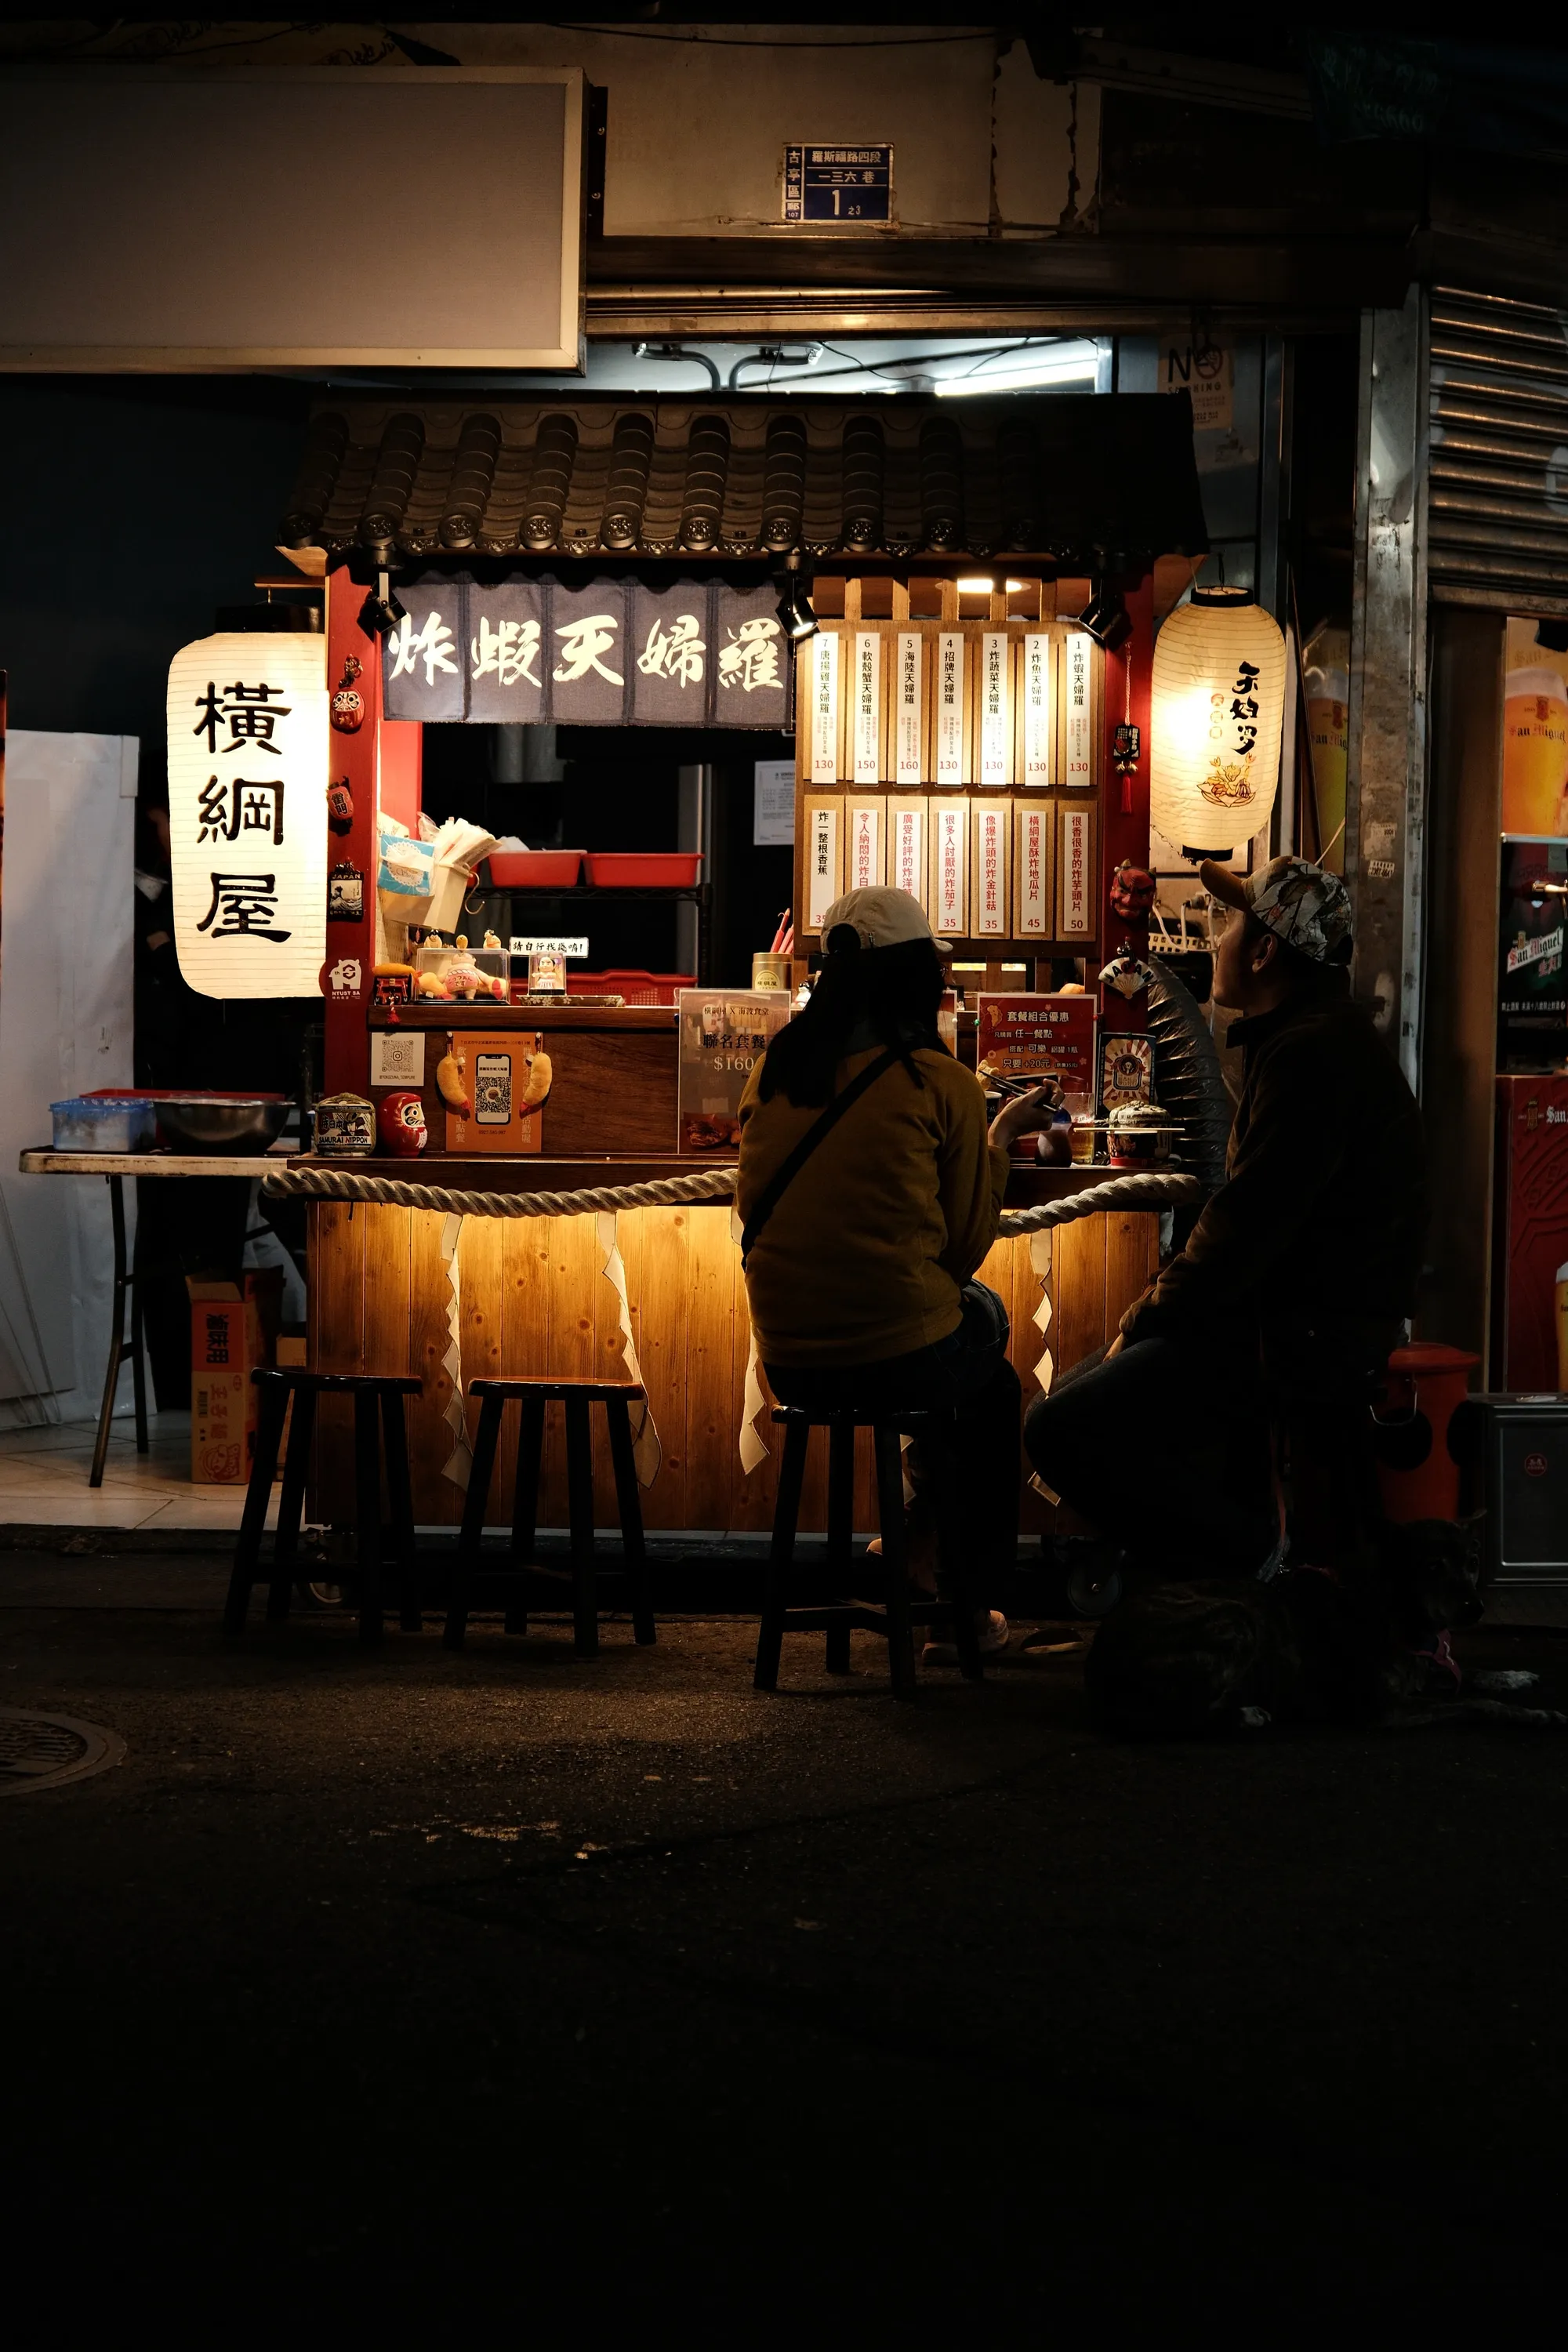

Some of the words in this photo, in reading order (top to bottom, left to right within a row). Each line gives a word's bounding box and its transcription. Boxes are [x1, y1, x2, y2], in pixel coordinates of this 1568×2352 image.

[811, 151, 881, 163] 羅斯福路四段
[788, 151, 801, 198] 古亭區
[818, 171, 857, 183] 一三六
[862, 170, 875, 183] 巷
[832, 190, 840, 216] 1
[848, 205, 861, 216] 之3
[823, 639, 828, 648] 7
[865, 639, 870, 648] 6
[907, 640, 913, 648] 5
[947, 639, 953, 648] 4
[992, 639, 998, 648] 3
[1033, 641, 1040, 649] 2
[1076, 641, 1081, 649] 1
[388, 611, 784, 693] 炸蝦天婦羅
[820, 650, 830, 713] 唐揚雞天婦羅
[862, 652, 873, 715] 軟殼蟹天婦羅
[905, 652, 915, 704] 海陸天婦羅
[944, 652, 955, 704] 招牌天婦羅
[989, 651, 1000, 714] 炸蔬菜天婦羅
[1032, 654, 1042, 706] 炸魚天婦羅
[1073, 653, 1084, 706] 炸蝦天婦羅
[815, 760, 833, 769] 130
[858, 760, 876, 769] 150
[900, 760, 918, 770] 160
[939, 760, 957, 770] 130
[985, 760, 1003, 770] 130
[1028, 762, 1047, 771] 130
[1069, 763, 1088, 771] 130
[193, 681, 292, 944] 橫綱屋
[818, 811, 829, 876] 炸一整根香蕉
[945, 815, 956, 910] 很多人討厭的炸茄子
[985, 815, 996, 911] 像爆炸頭的炸金針菇
[1029, 815, 1040, 901] 橫綱屋酥炸地瓜片
[1072, 816, 1082, 912] 很香很香的炸芋頭片
[944, 918, 956, 927] 35
[985, 920, 997, 929] 35
[1028, 919, 1040, 928] 45
[1071, 920, 1083, 929] 50
[1508, 946, 1528, 965] San
[1530, 931, 1560, 957] Miguel
[1007, 1011, 1069, 1022] 套餐組合優惠
[1015, 1029, 1053, 1039] 任一餐點
[703, 1034, 766, 1049] 聯名套餐
[1028, 1044, 1047, 1054] 可樂
[713, 1056, 754, 1072] $160
[1003, 1058, 1022, 1069] 只要
[1024, 1058, 1051, 1069] +20元
[1546, 1104, 1566, 1124] San
[206, 1314, 229, 1364] 滷味用
